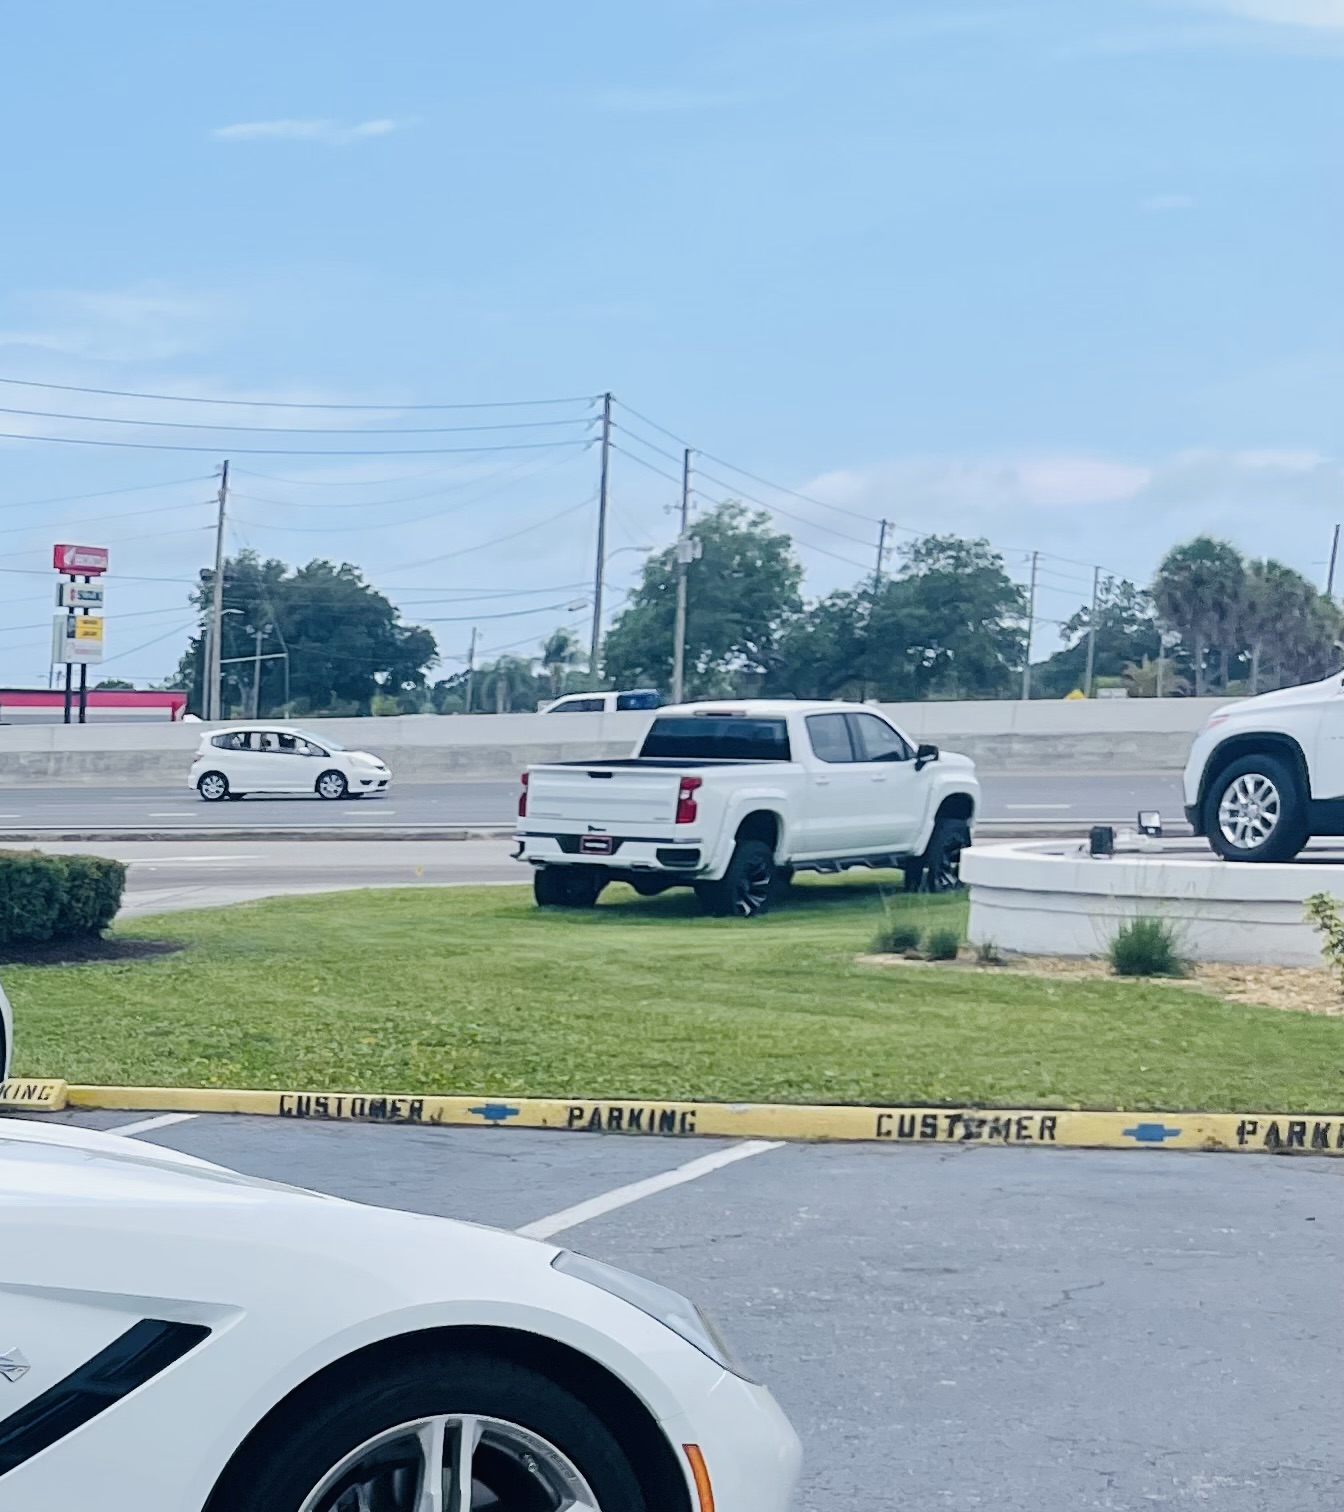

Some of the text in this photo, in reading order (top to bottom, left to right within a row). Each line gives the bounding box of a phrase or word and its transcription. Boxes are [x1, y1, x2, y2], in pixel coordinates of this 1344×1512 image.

[279, 1094, 424, 1122] CUSTOMER
[568, 1106, 697, 1134] PARKING
[876, 1113, 1057, 1142] CUSTOMER
